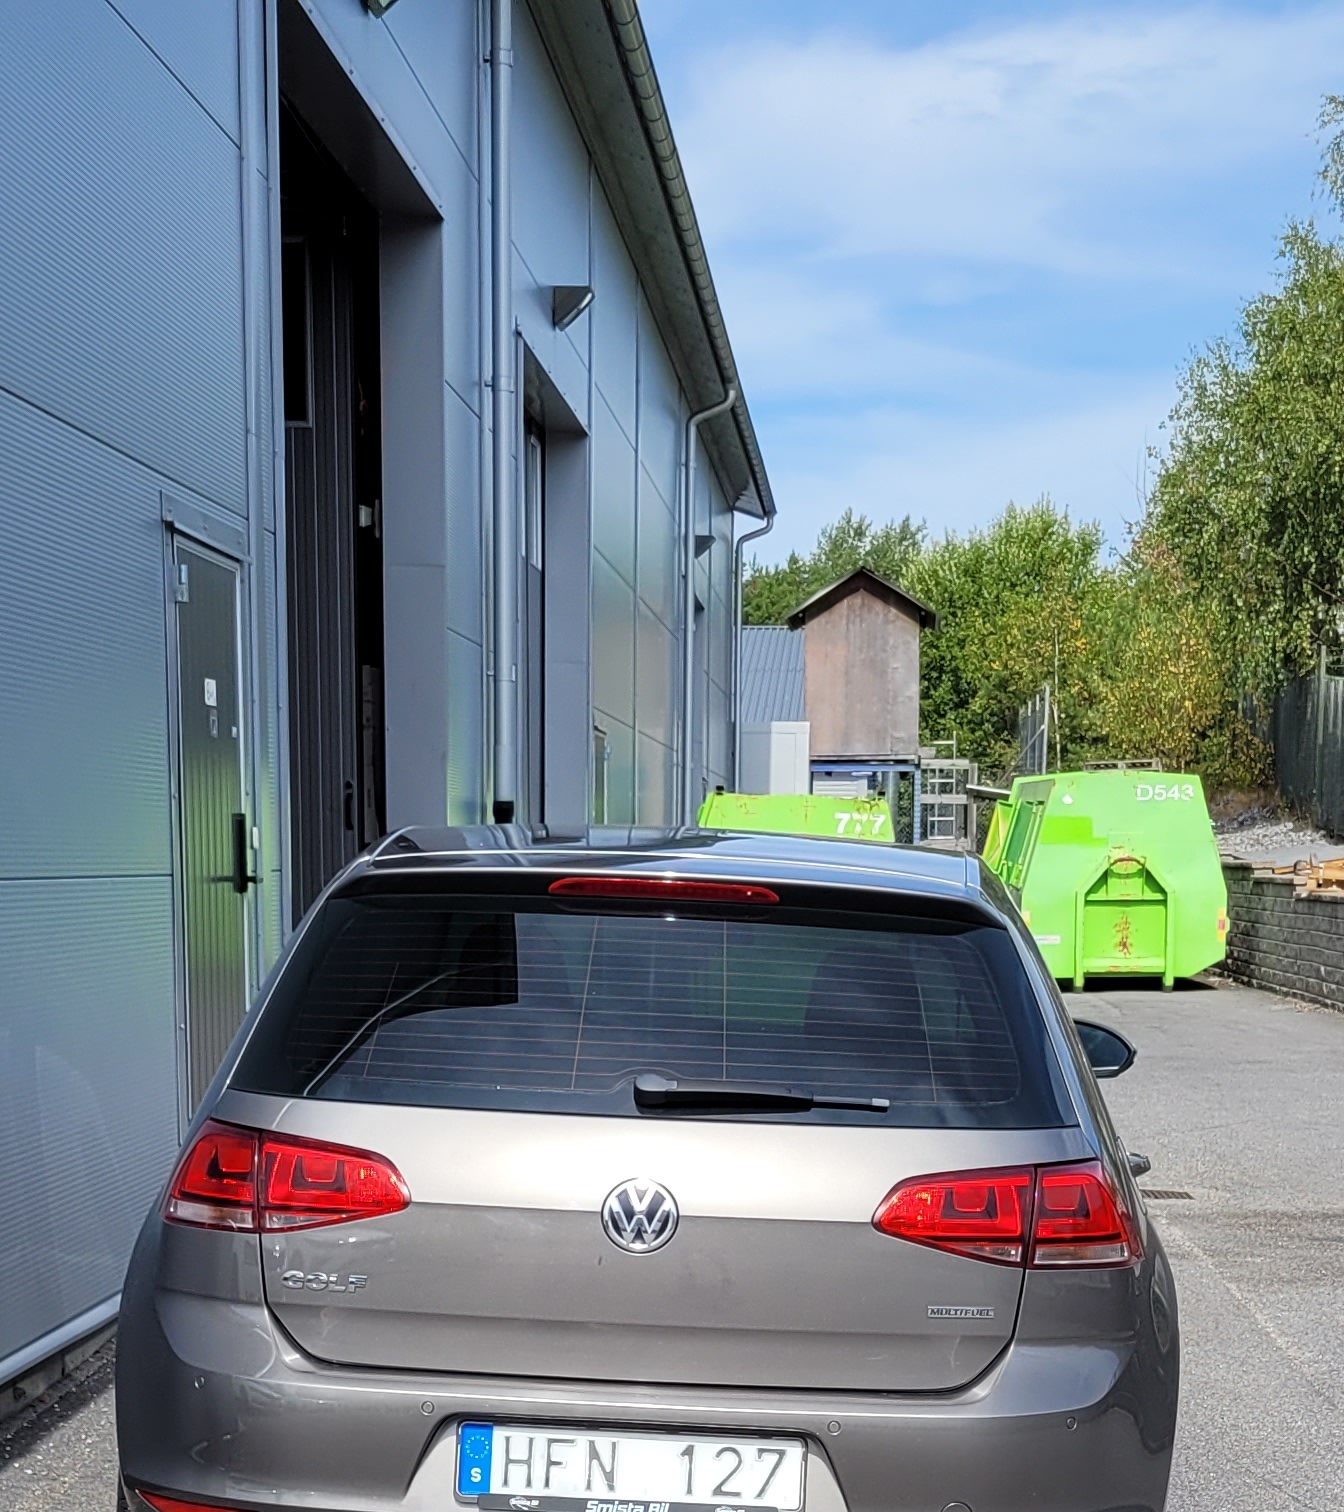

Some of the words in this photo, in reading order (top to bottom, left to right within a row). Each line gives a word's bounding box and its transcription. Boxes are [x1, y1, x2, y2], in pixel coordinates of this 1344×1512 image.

[1136, 783, 1194, 801] D543
[834, 812, 886, 835] 777
[281, 1269, 368, 1293] GOLF
[928, 1307, 994, 1317] MULTIFUEL
[470, 1466, 482, 1483] S
[501, 1435, 618, 1493] HFN
[678, 1444, 788, 1500] 127
